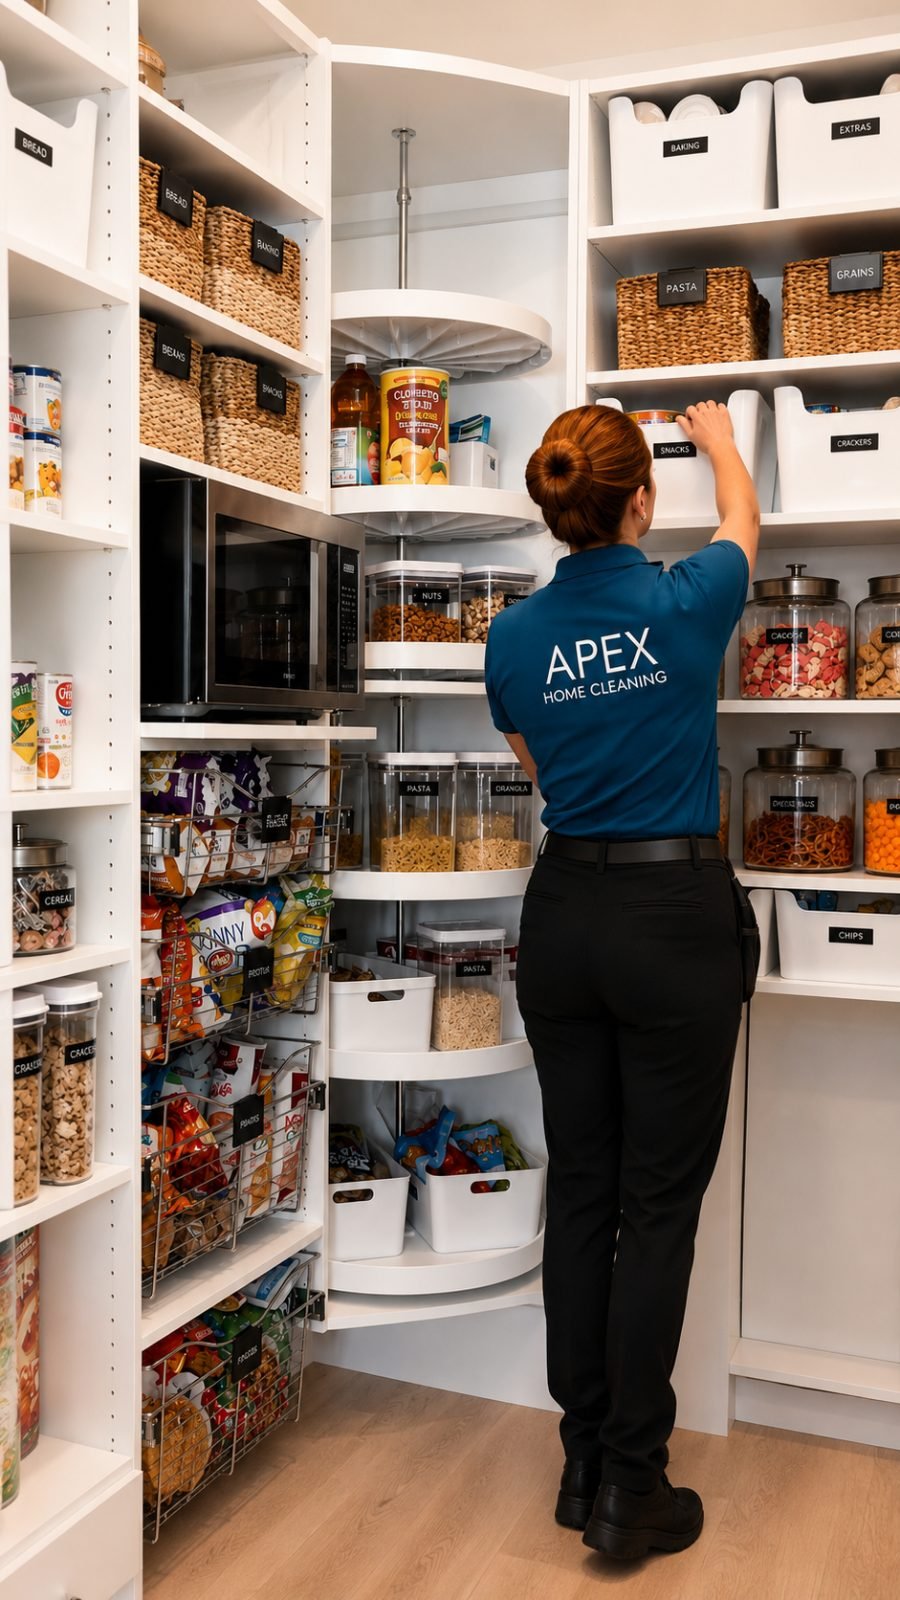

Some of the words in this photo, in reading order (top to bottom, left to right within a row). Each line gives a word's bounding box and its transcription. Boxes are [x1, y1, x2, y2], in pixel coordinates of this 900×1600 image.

[839, 122, 872, 135] EXTRAS
[22, 137, 48, 159] BREAD
[671, 141, 700, 153] BAKING
[836, 267, 874, 280] GRAINS
[666, 282, 697, 294] PASTA
[837, 437, 872, 449] CRACKERS
[660, 446, 690, 456] SNACKS
[422, 593, 442, 601] NUTS
[546, 627, 658, 685] APEX
[543, 685, 586, 704] HOME
[590, 670, 668, 697] CLEANING
[407, 785, 430, 793] PASTA
[44, 894, 73, 906] CEREAL
[838, 931, 863, 941] CHIPS
[463, 965, 486, 973] PASTA
